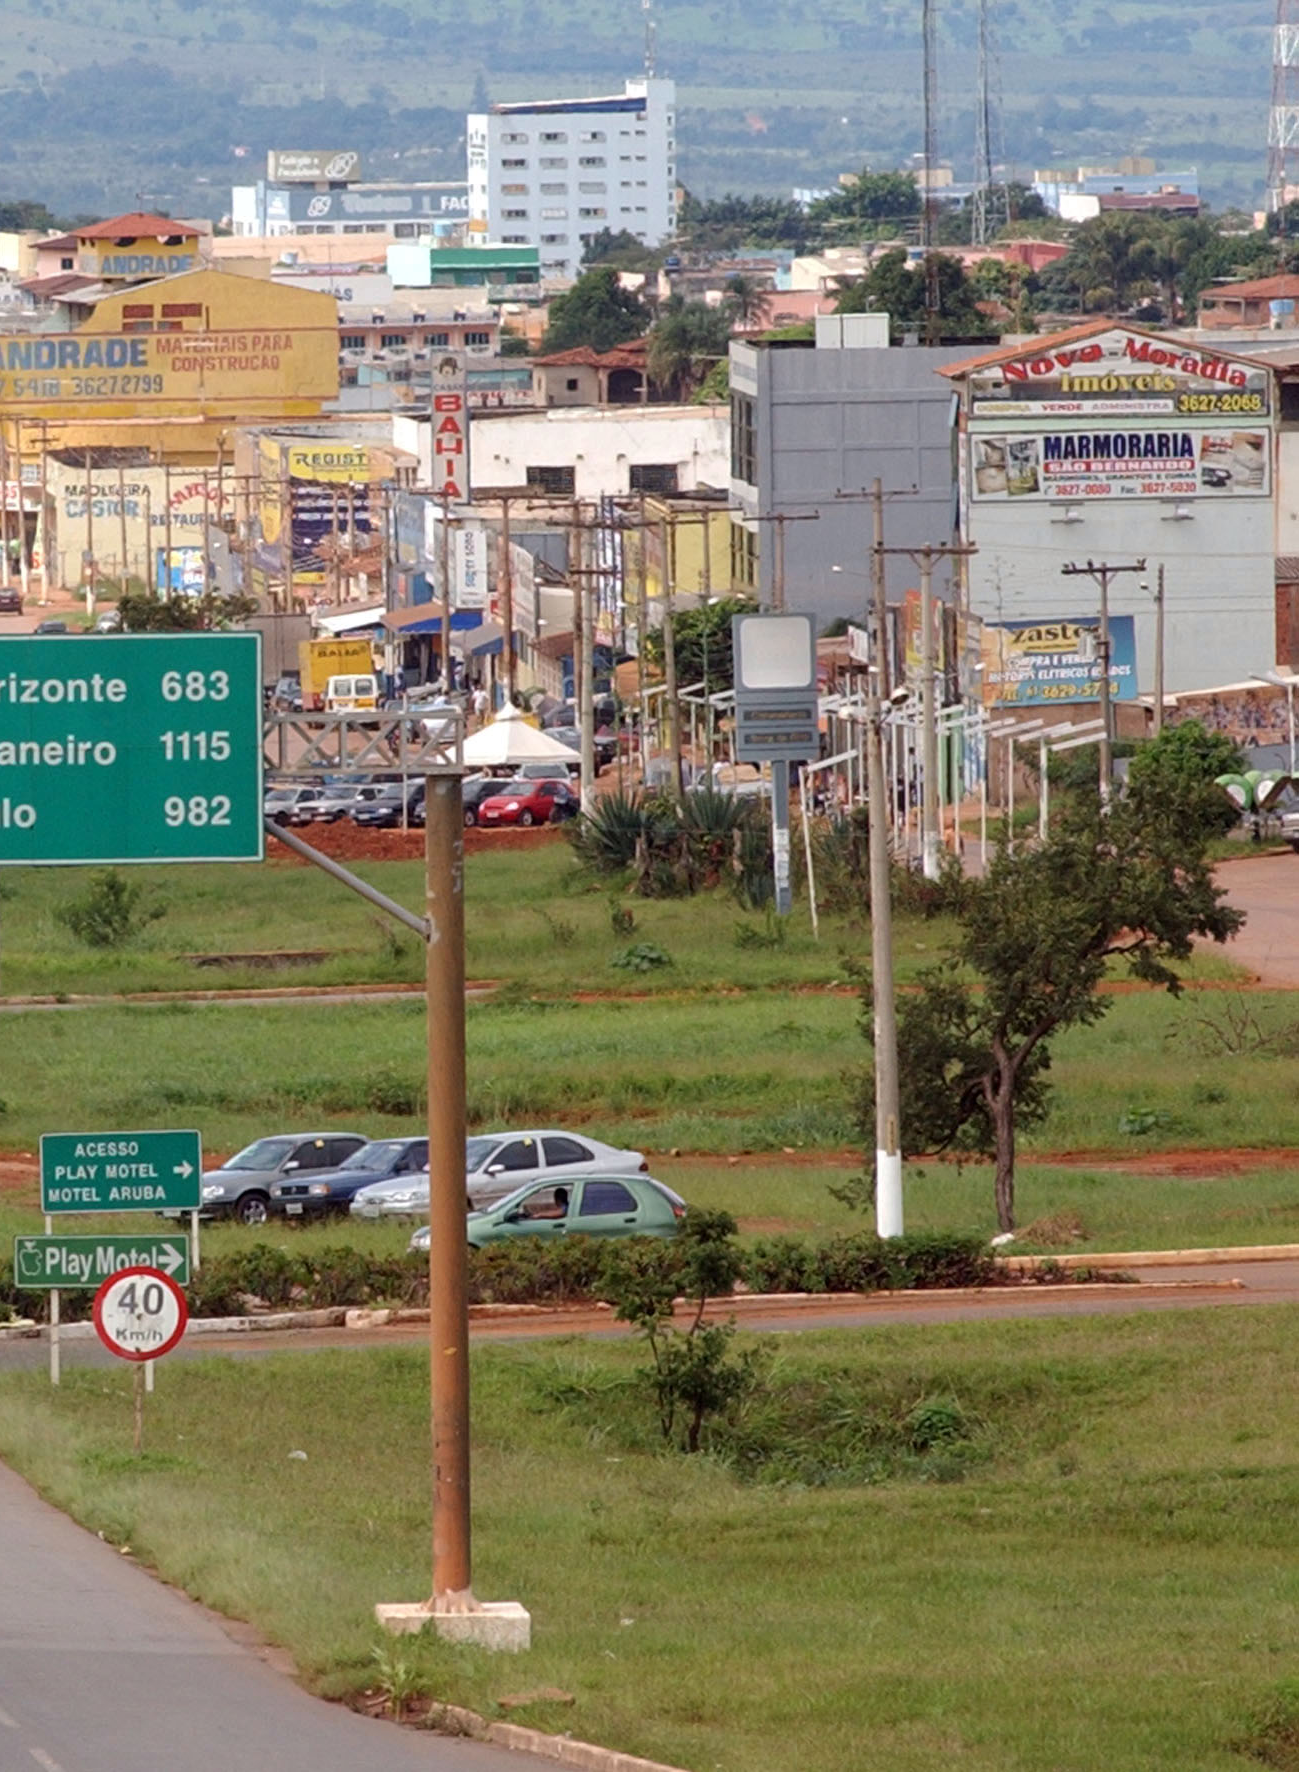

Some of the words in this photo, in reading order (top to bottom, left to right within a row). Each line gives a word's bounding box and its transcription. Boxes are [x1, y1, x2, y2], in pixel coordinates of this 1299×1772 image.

[101, 255, 195, 275] ANDRADE
[156, 335, 248, 355] MATERIAIS
[252, 334, 293, 352] PARA
[1001, 344, 1105, 385] Nova
[1122, 337, 1247, 387] Moradia
[1060, 369, 1176, 392] Imóveis
[1042, 403, 1083, 411] VENDE
[434, 394, 462, 498] BAHIA
[1043, 433, 1195, 460] MARMORARIA
[1048, 460, 1087, 472] SÃO
[1090, 460, 1192, 472] BERNARDO
[161, 670, 230, 702] 683
[160, 731, 231, 762] 1115
[164, 796, 231, 827] 982
[74, 1142, 139, 1157] ACESSO
[55, 1165, 98, 1180] PLAY
[105, 1163, 159, 1178] MOTEL
[48, 1187, 101, 1202] MOTEL
[108, 1185, 166, 1201] ARUBA
[117, 1282, 165, 1315] 40
[115, 1329, 164, 1342] Km/h
